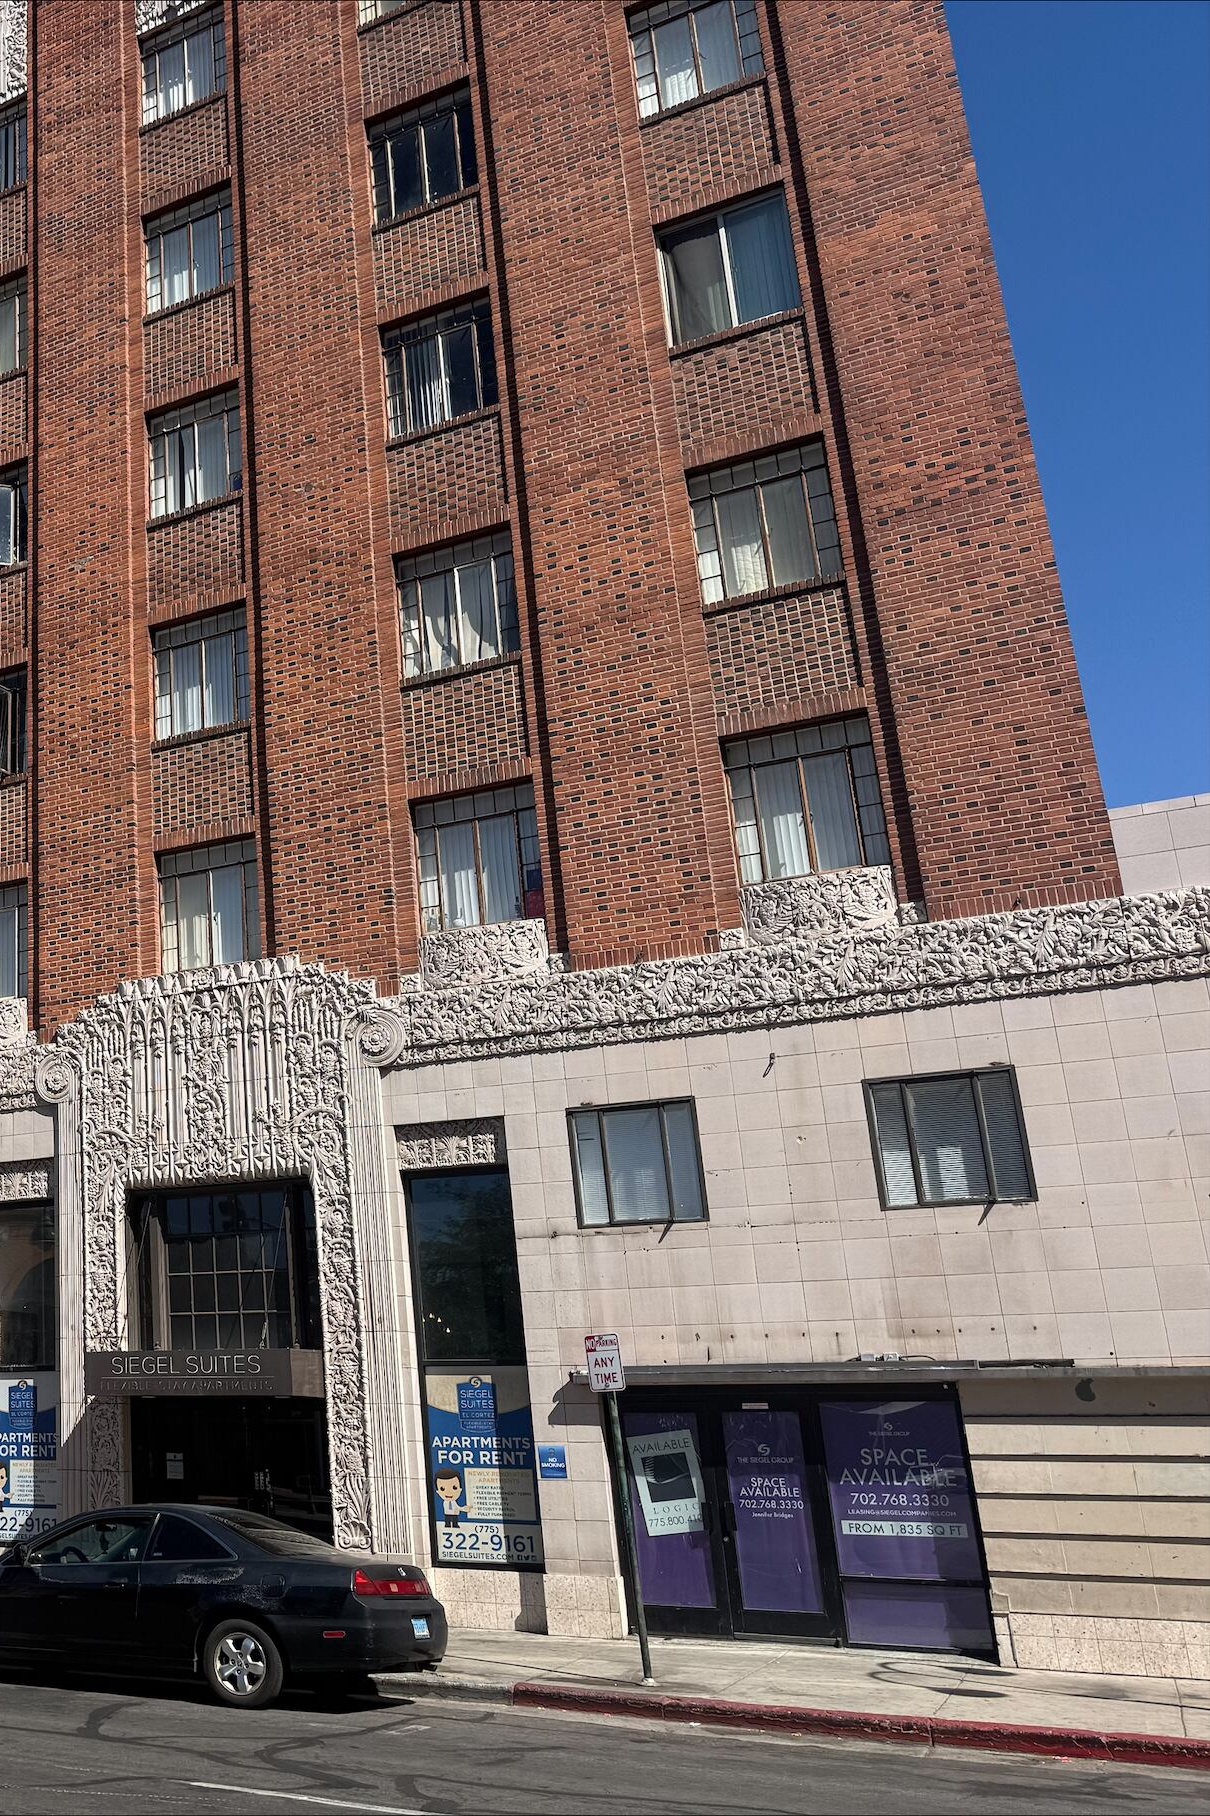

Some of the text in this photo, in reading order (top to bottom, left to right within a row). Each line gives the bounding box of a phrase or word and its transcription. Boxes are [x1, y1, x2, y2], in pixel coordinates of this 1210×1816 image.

[586, 1338, 596, 1350] NO
[111, 1355, 262, 1375] SIEGEL SUITES
[594, 1357, 615, 1368] ANY
[594, 1372, 619, 1384] TIME
[10, 1391, 34, 1400] SIEGEL
[460, 1389, 493, 1399] SIEGEL
[10, 1400, 35, 1409] SUITES
[460, 1399, 495, 1409] SUITES
[432, 1436, 531, 1449] APARTMENTS
[632, 1437, 691, 1455] AVAILABLE
[21, 1445, 56, 1457] RENT
[860, 1448, 929, 1466] SPACE
[437, 1450, 527, 1466] FOR RENT
[750, 1477, 786, 1488] SPACE
[839, 1467, 957, 1487] AVAILABLE
[739, 1487, 800, 1498] AVAILABLE
[739, 1499, 804, 1509] 702.768.3330
[850, 1493, 950, 1507] 702.768.3330
[14, 1509, 33, 1517] (775)
[474, 1525, 500, 1534] (775)
[848, 1522, 962, 1536] FROM 1,835 SQ FT
[442, 1532, 535, 1553] 322-9161
[441, 1551, 514, 1561] SIEGELSUITES.COM
